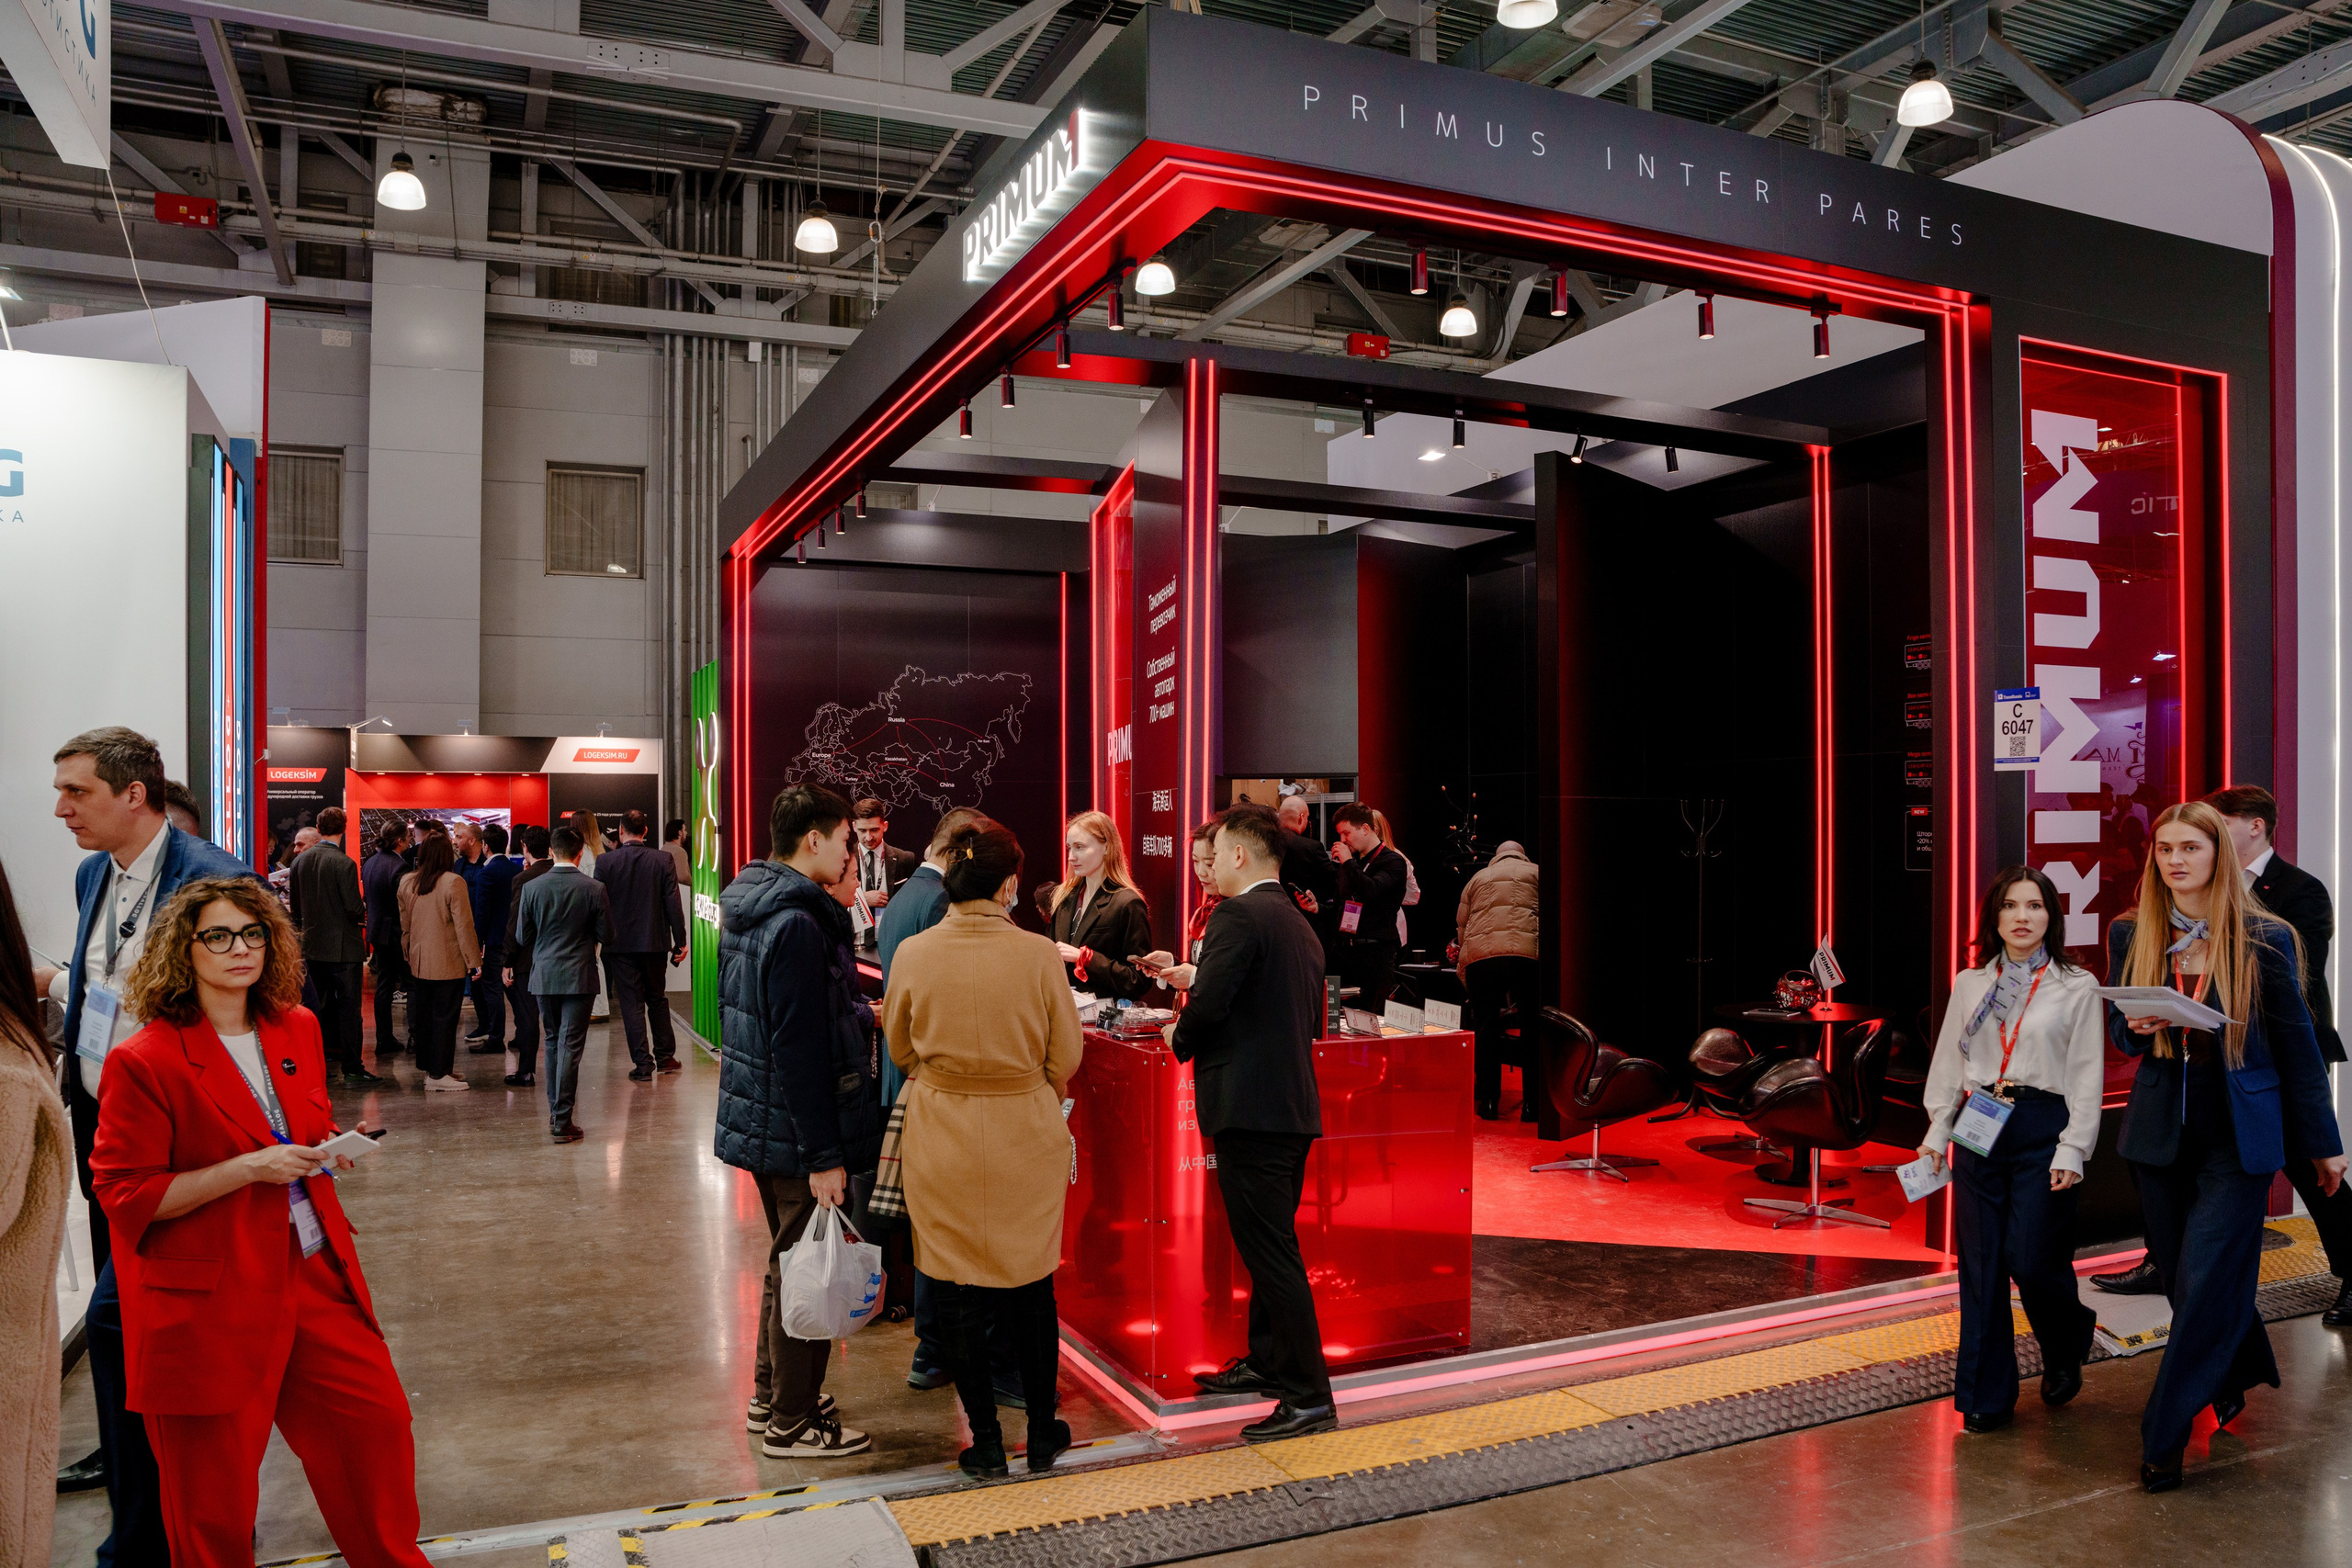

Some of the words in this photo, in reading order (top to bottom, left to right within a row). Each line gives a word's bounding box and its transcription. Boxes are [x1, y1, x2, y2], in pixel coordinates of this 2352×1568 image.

[1304, 85, 1546, 157] PRIMUS
[1606, 145, 1770, 204] INTER
[1819, 193, 1963, 246] PARES
[962, 107, 1080, 282] PRIMUM
[1148, 573, 1177, 613] Таможенный
[1150, 603, 1176, 635] перевозчик
[1147, 646, 1176, 679] Собственный
[1154, 675, 1176, 698] автопарк
[1159, 701, 1175, 720] машин
[2013, 703, 2023, 718] C
[2002, 719, 2034, 735] 6047
[1818, 951, 1836, 981] PRIMUM
